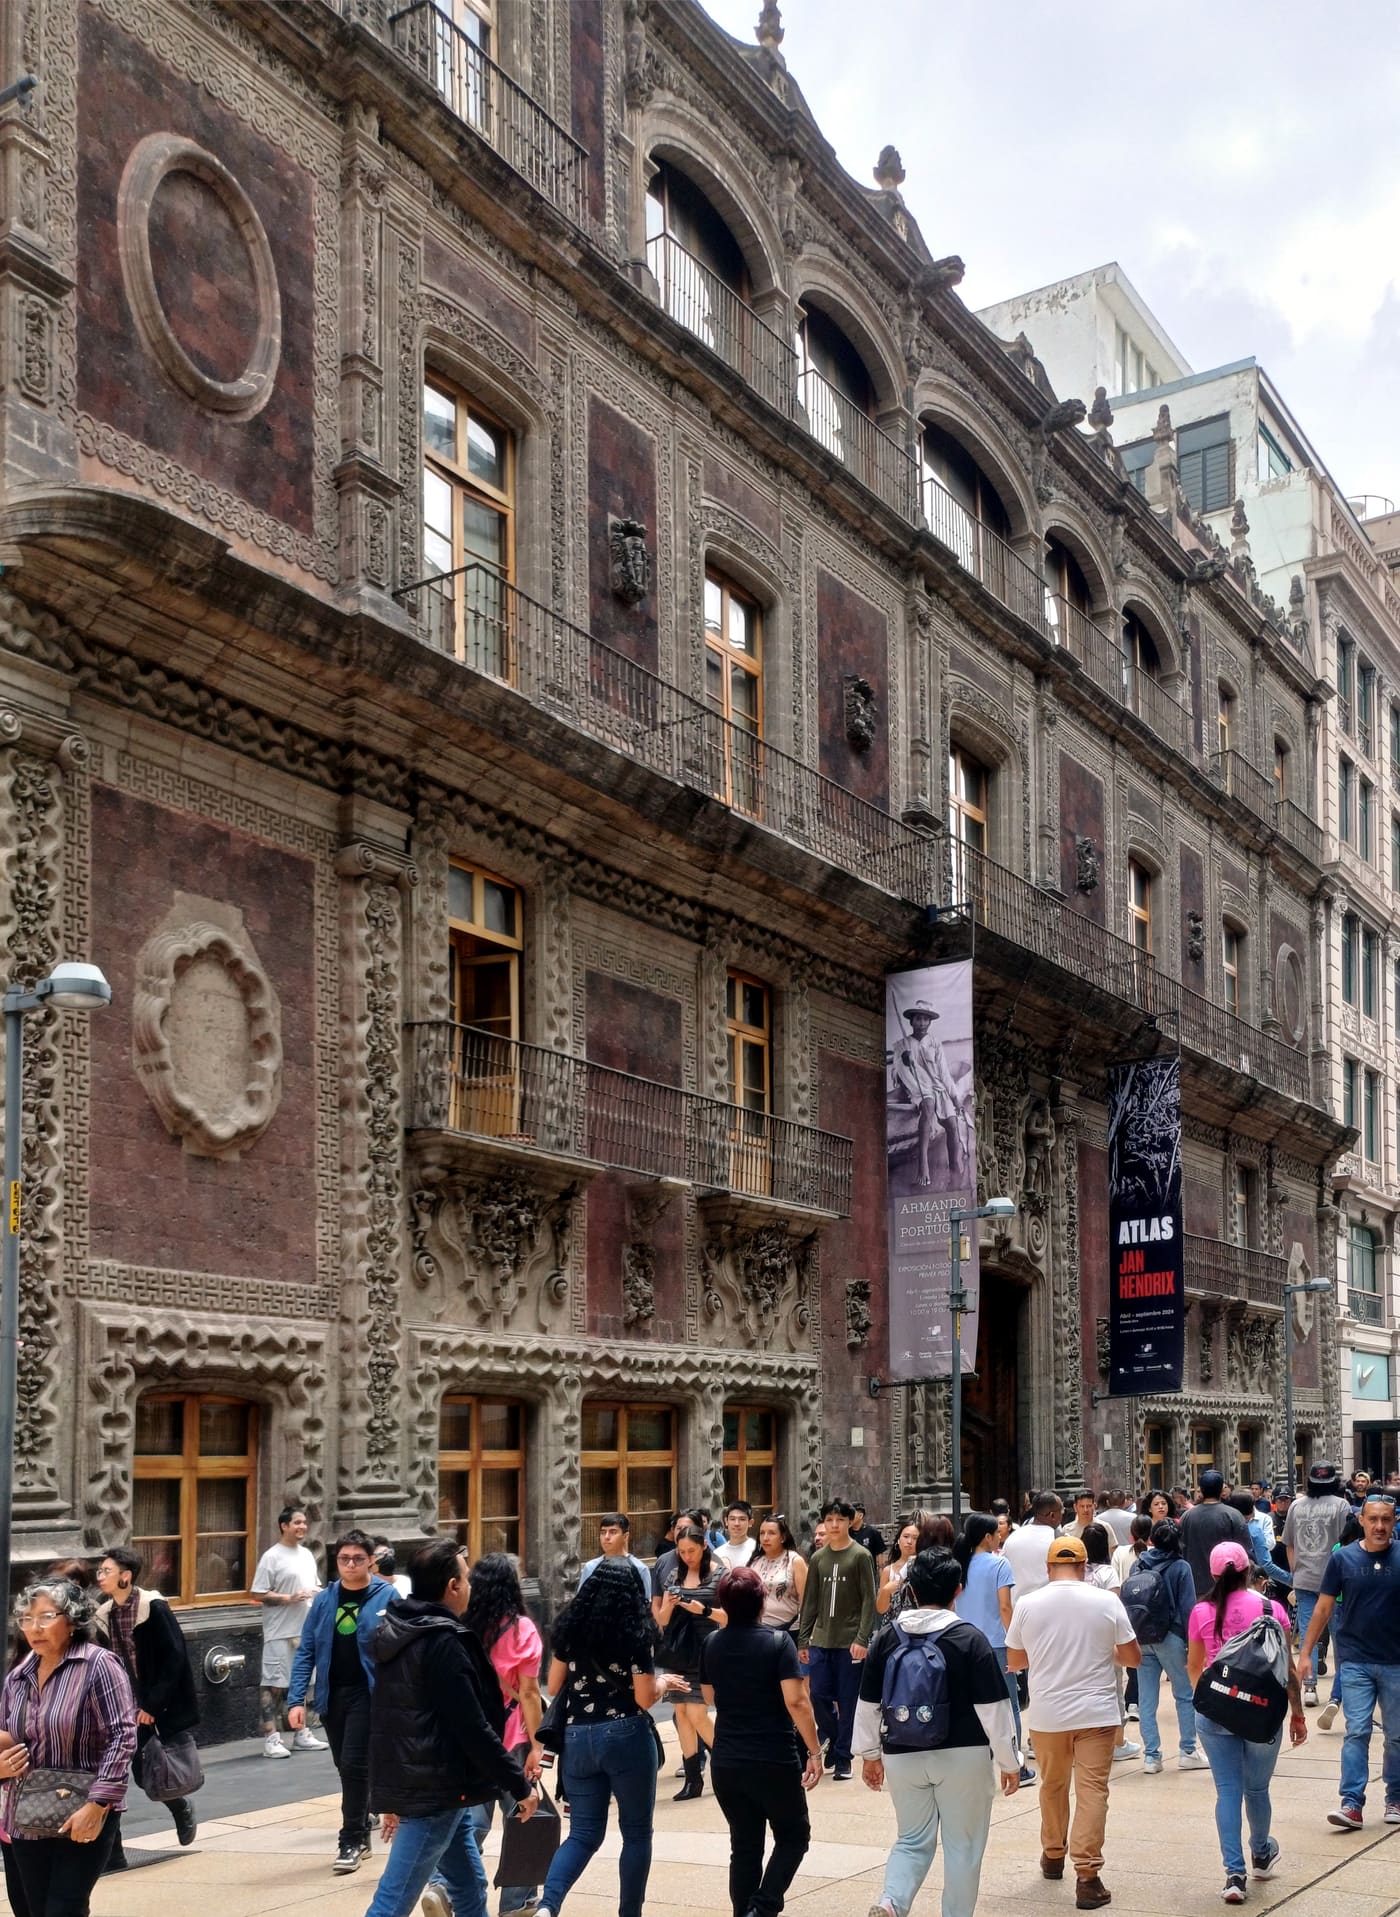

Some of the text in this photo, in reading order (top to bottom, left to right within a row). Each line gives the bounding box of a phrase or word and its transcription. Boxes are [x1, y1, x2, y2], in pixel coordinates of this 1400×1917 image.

[900, 1197, 967, 1214] ARMANDO
[900, 1222, 968, 1238] PORTUGL
[1119, 1216, 1174, 1245] ATLAS
[1119, 1249, 1145, 1274] JAN
[1119, 1271, 1175, 1299] HENDRIX
